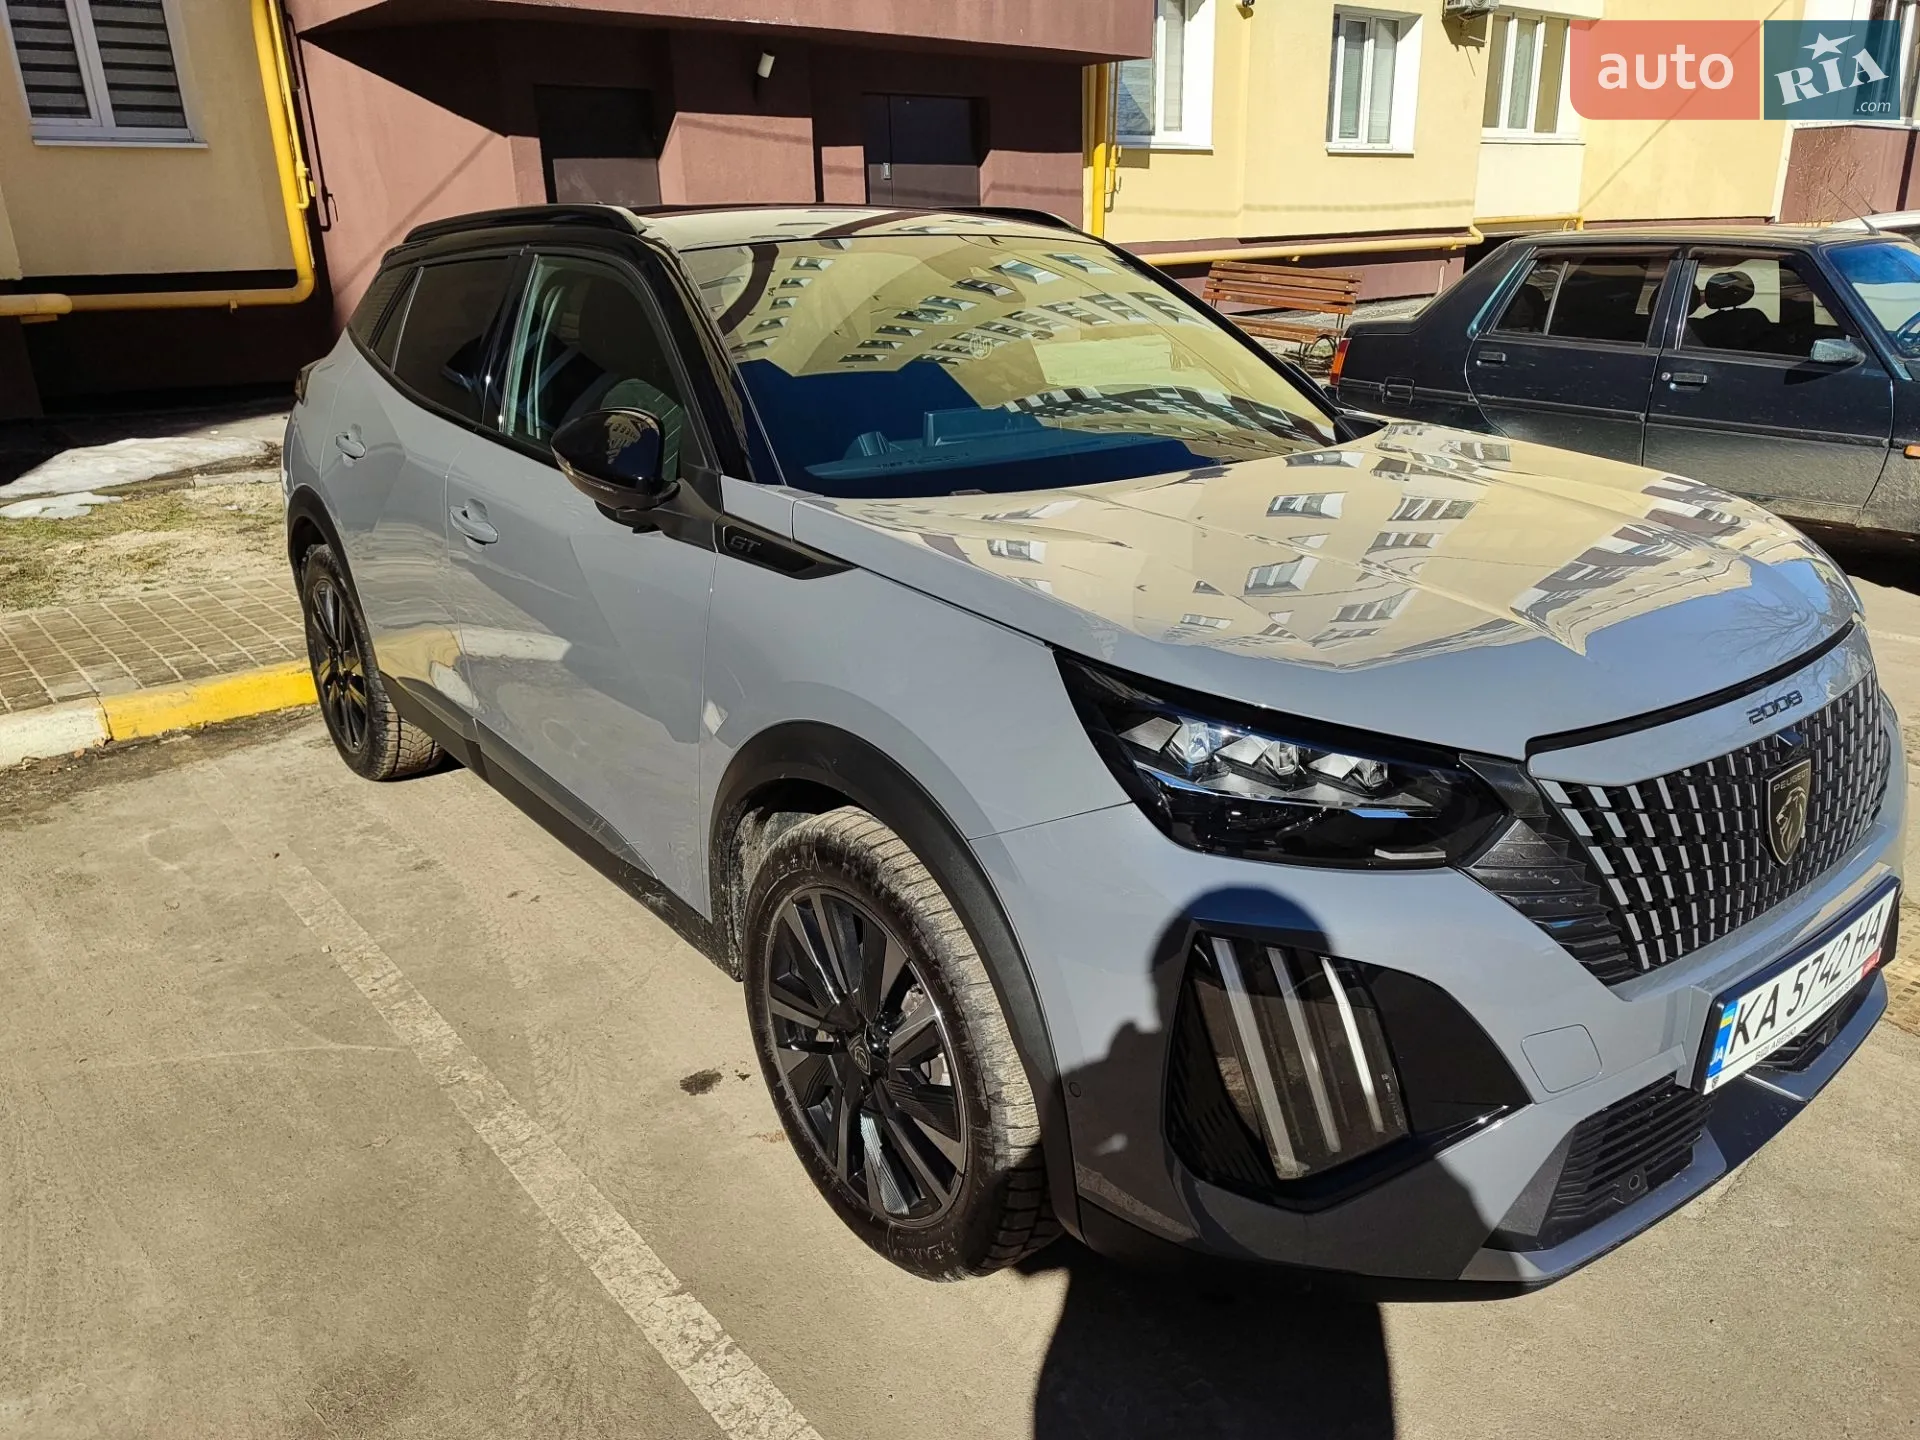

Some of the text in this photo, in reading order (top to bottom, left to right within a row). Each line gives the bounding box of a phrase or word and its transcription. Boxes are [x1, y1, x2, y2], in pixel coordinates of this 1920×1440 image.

[730, 535, 761, 553] GT
[1747, 689, 1803, 725] 2008
[1773, 768, 1810, 793] PEUGEOT
[1786, 932, 1852, 1017] 5742
